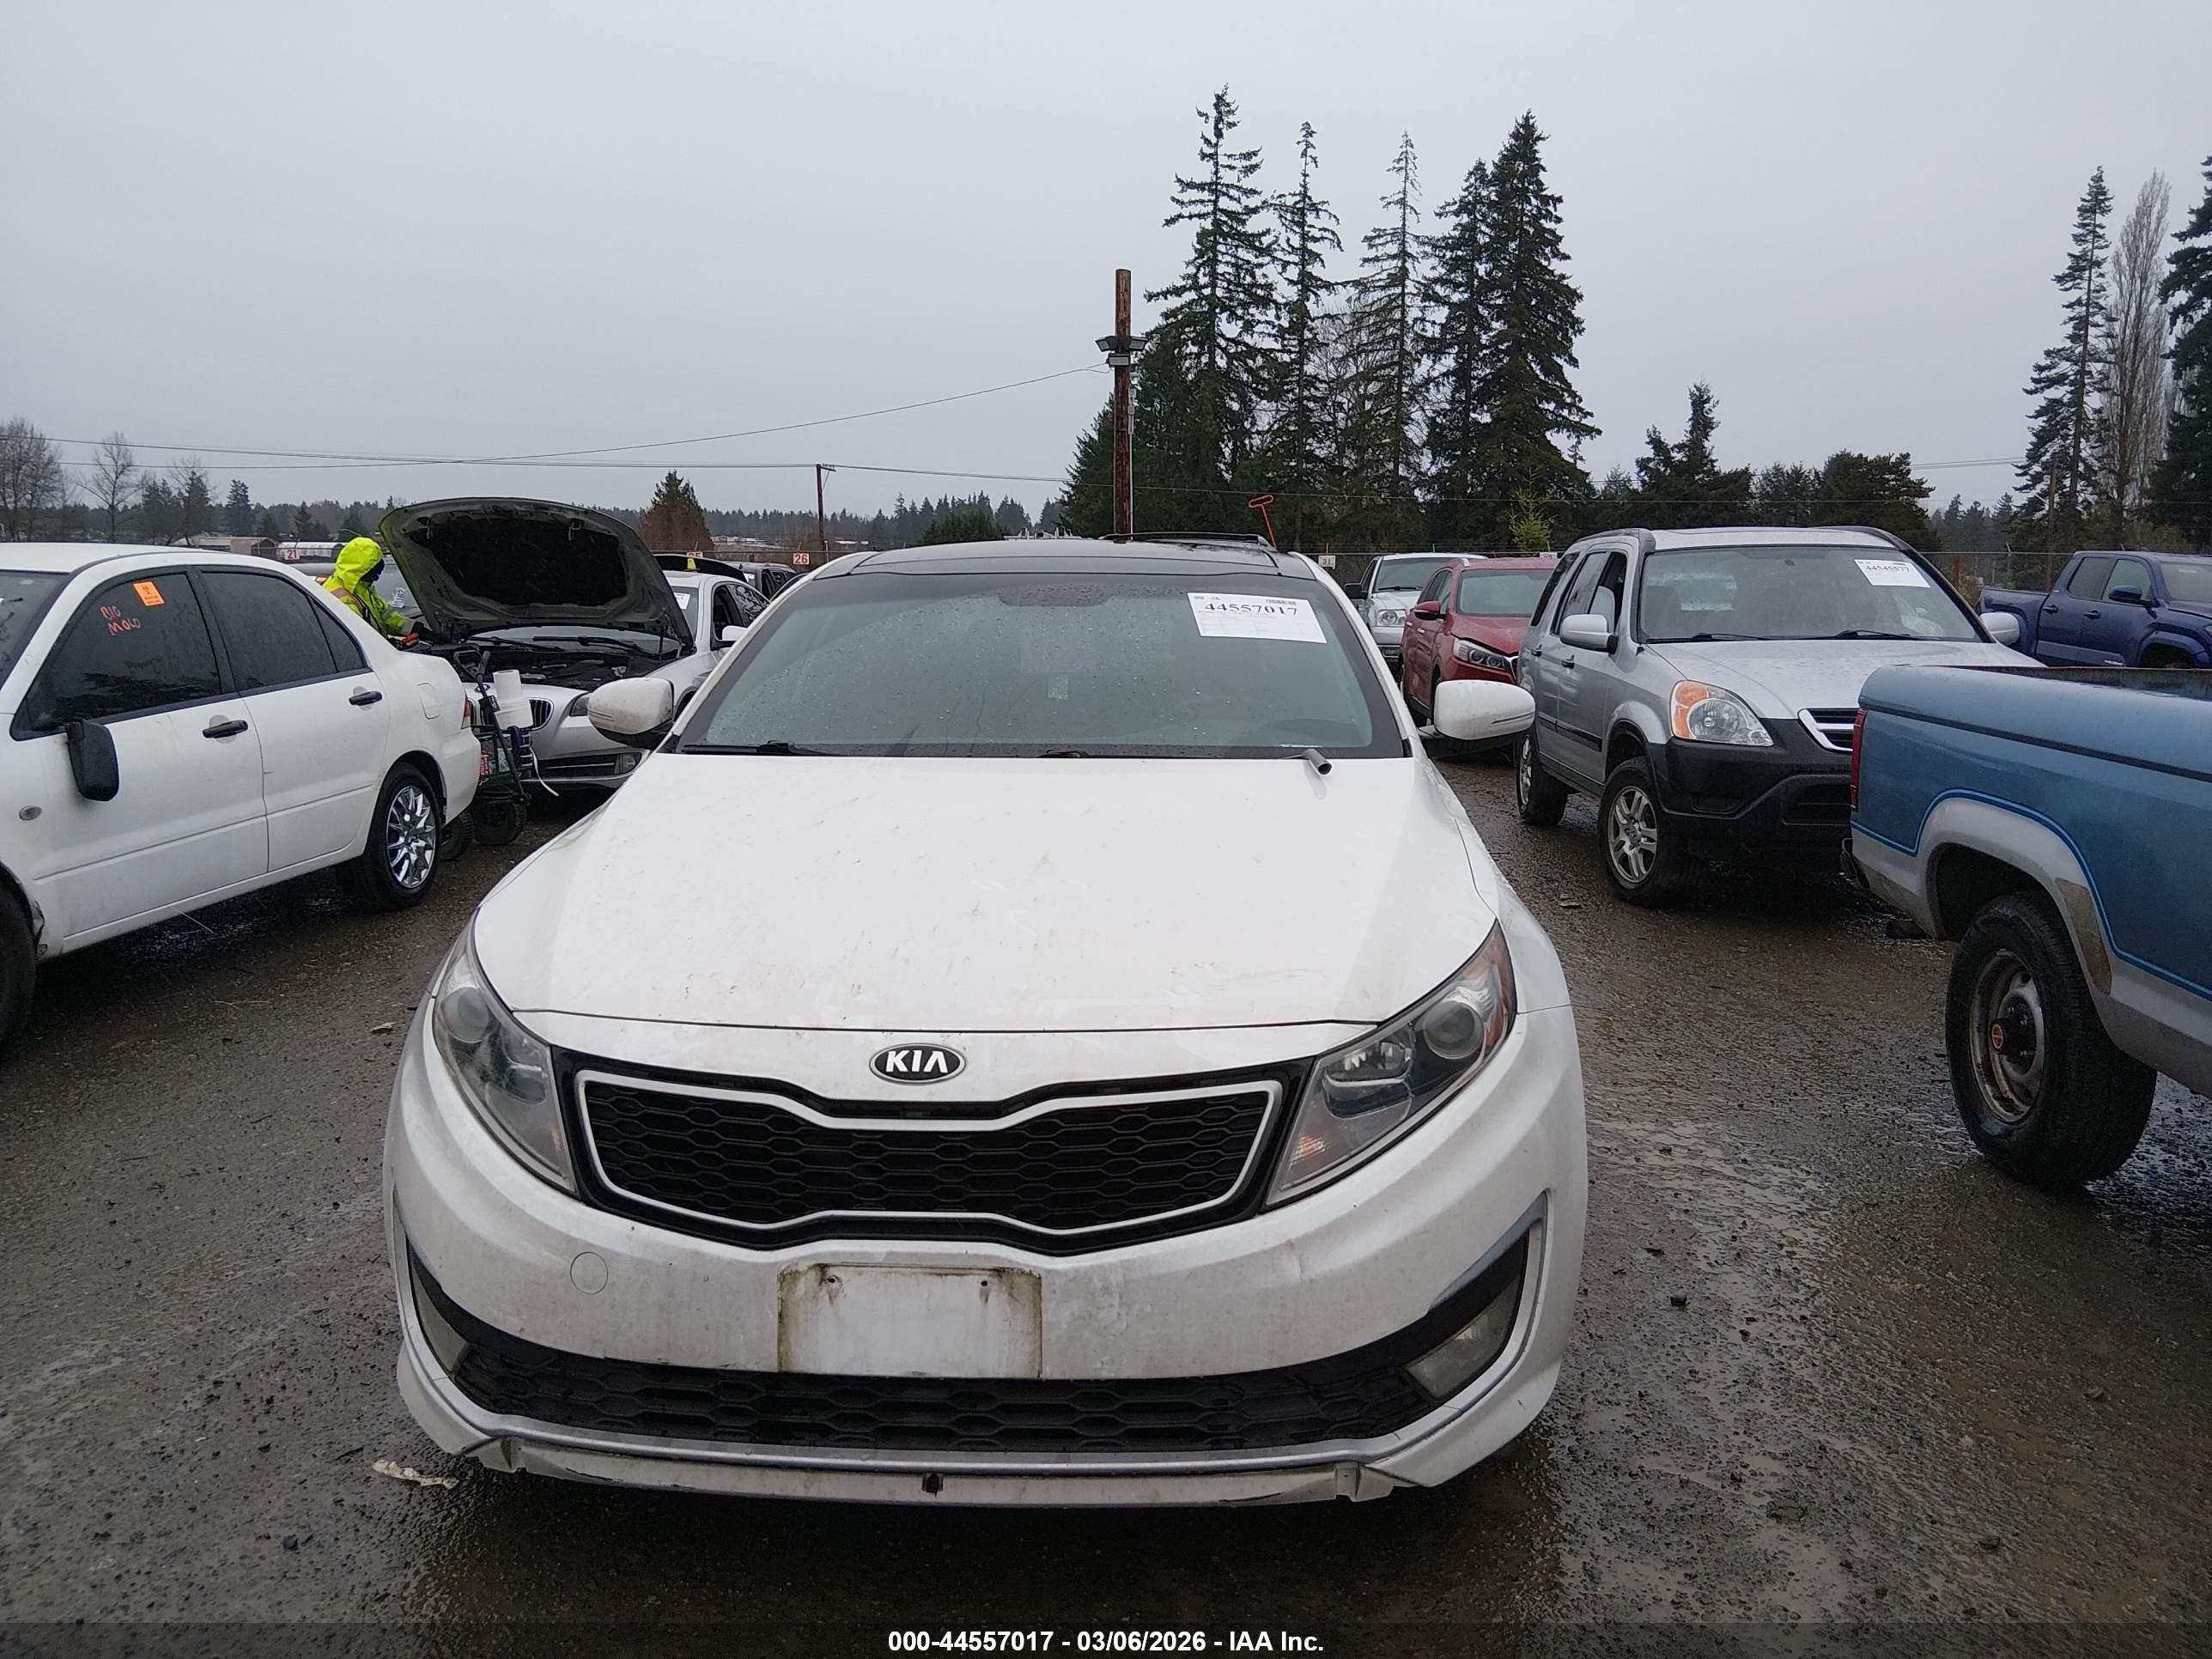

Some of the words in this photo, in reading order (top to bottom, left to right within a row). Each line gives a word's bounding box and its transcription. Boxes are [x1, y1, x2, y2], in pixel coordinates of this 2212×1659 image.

[287, 549, 297, 559] 21
[794, 554, 808, 564] 26
[1204, 603, 1297, 617] 44557017
[885, 1049, 949, 1073] KIA
